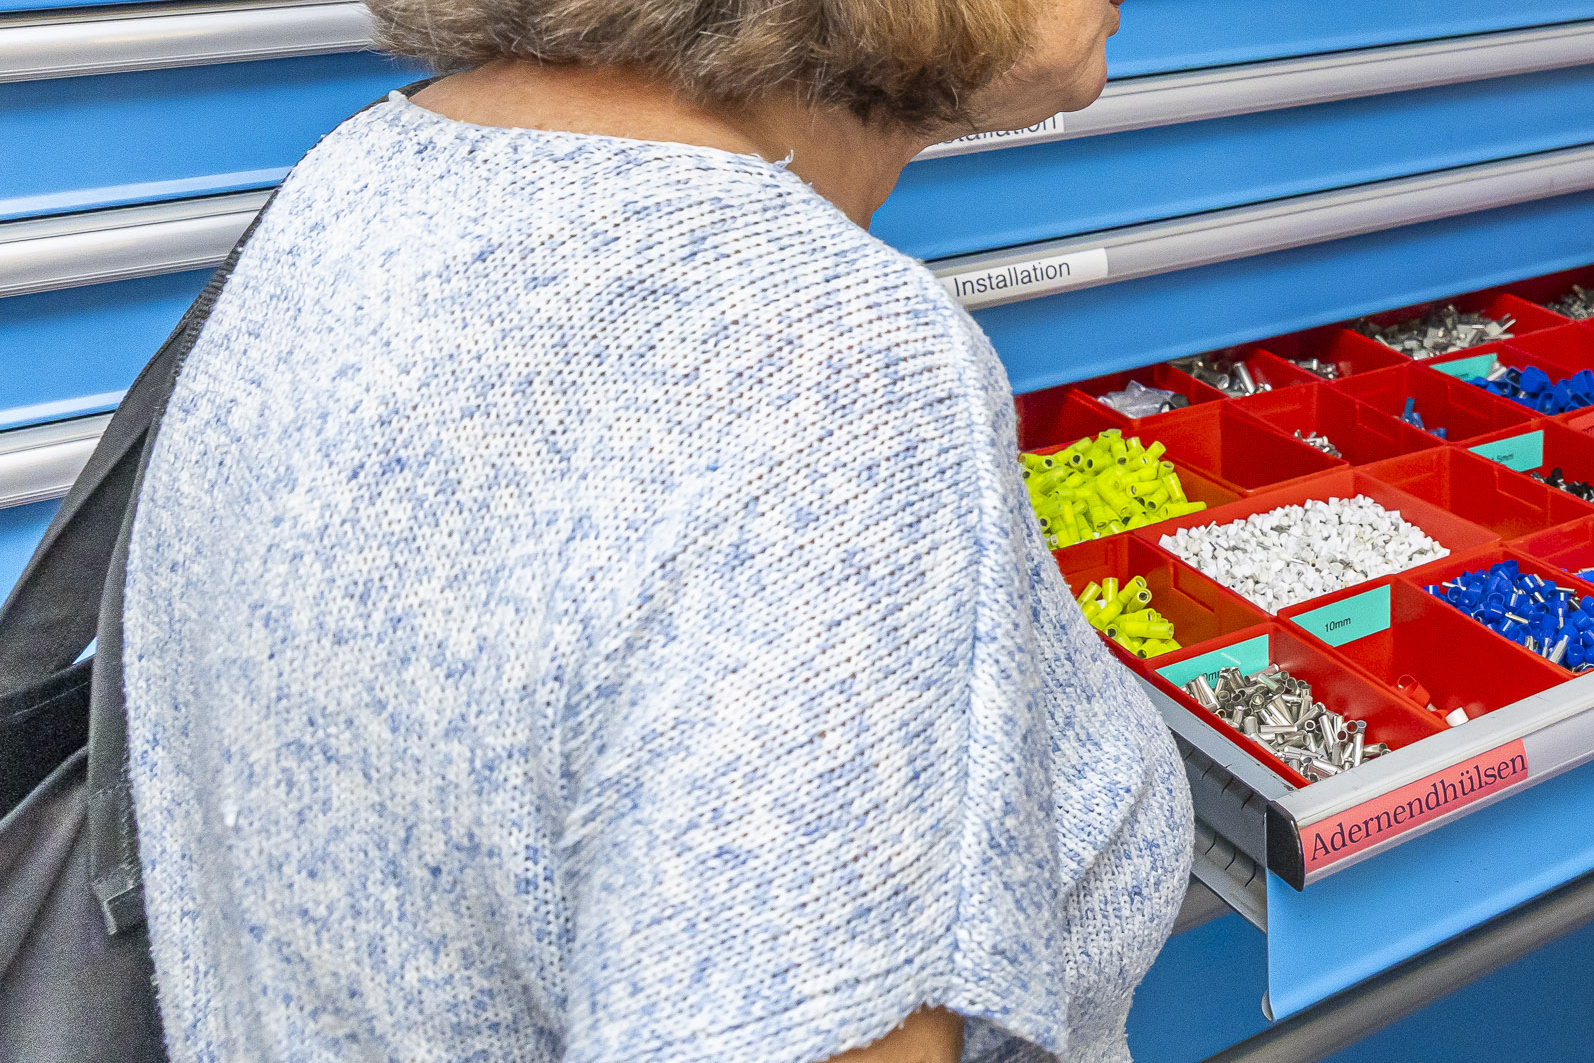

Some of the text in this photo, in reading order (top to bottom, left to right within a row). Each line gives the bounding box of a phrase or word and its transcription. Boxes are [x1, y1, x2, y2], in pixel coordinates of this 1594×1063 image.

[953, 262, 1071, 297] Installation
[1325, 617, 1352, 633] 10mm
[1310, 753, 1528, 862] Adernendhülsen
